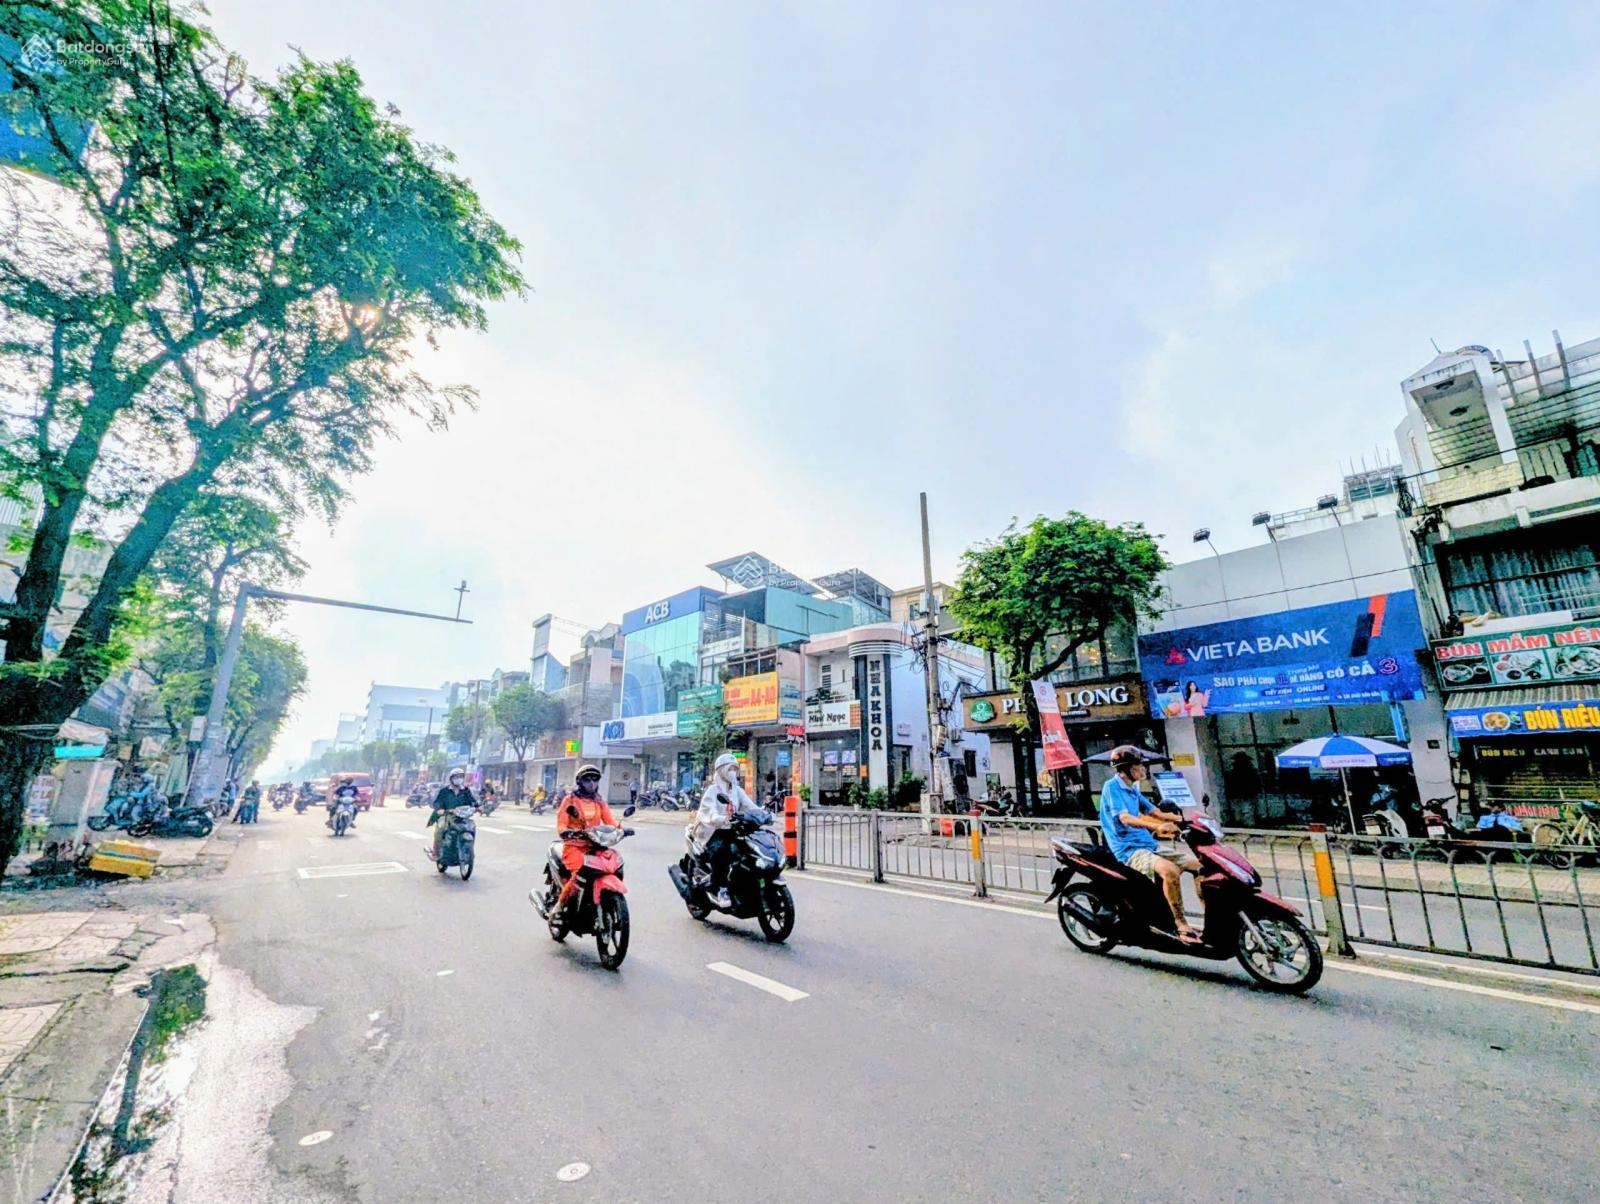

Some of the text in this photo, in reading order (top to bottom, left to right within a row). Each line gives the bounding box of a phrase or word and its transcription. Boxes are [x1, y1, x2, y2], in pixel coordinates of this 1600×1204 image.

[644, 601, 671, 624] ACB
[1435, 642, 1483, 660] BÚN
[1213, 675, 1235, 688] SAO
[1326, 666, 1345, 679] CÓ
[1349, 660, 1376, 676] CẢ
[1379, 657, 1399, 674] 3
[1066, 686, 1129, 708] LONG
[1523, 706, 1560, 730] BÚN
[603, 721, 625, 740] ACB
